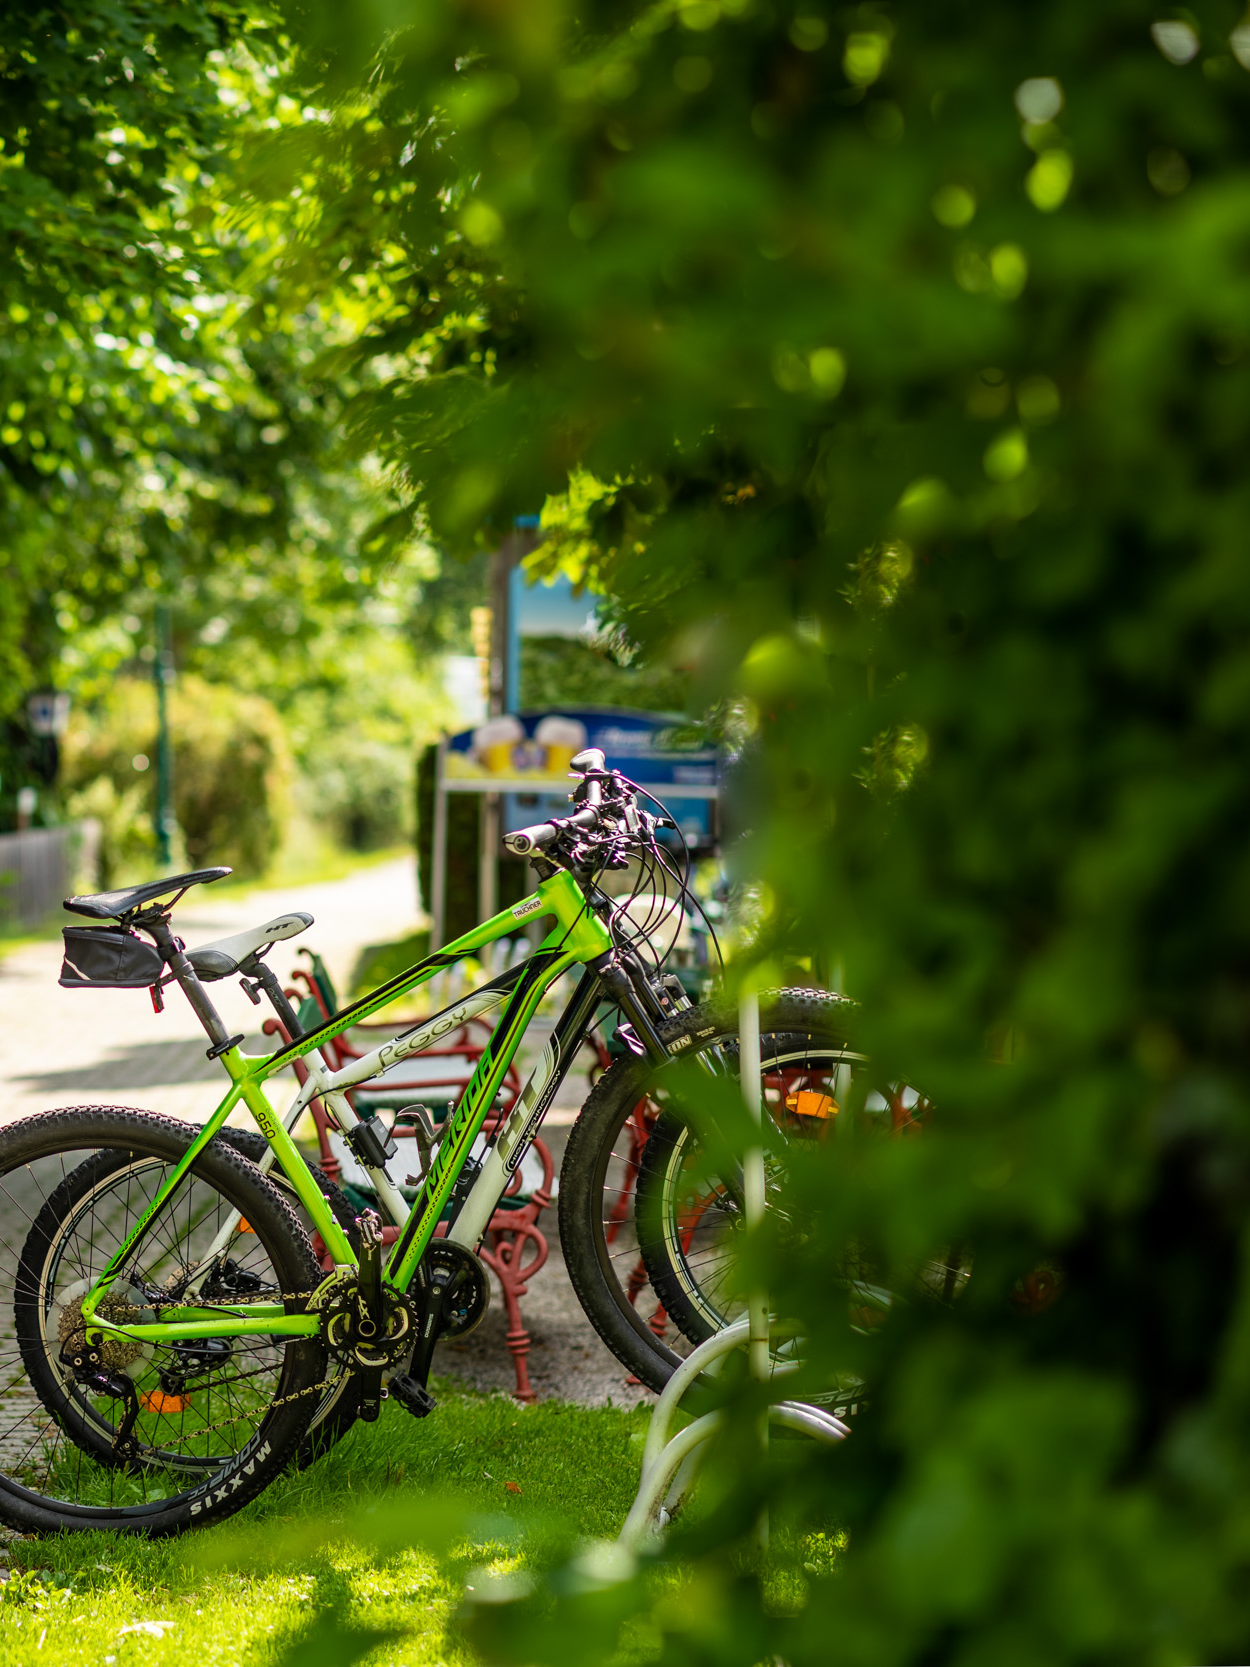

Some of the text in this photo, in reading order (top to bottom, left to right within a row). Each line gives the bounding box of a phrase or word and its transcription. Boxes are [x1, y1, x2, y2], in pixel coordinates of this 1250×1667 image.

[378, 1007, 467, 1068] PEGGY
[255, 1112, 276, 1140] 950
[425, 1052, 493, 1201] MERIDA
[497, 1065, 538, 1161] HT
[510, 1069, 561, 1166] HIGH TECHNOLOGY
[190, 1440, 272, 1516] MAXXIS
[209, 1429, 262, 1489] COMP
